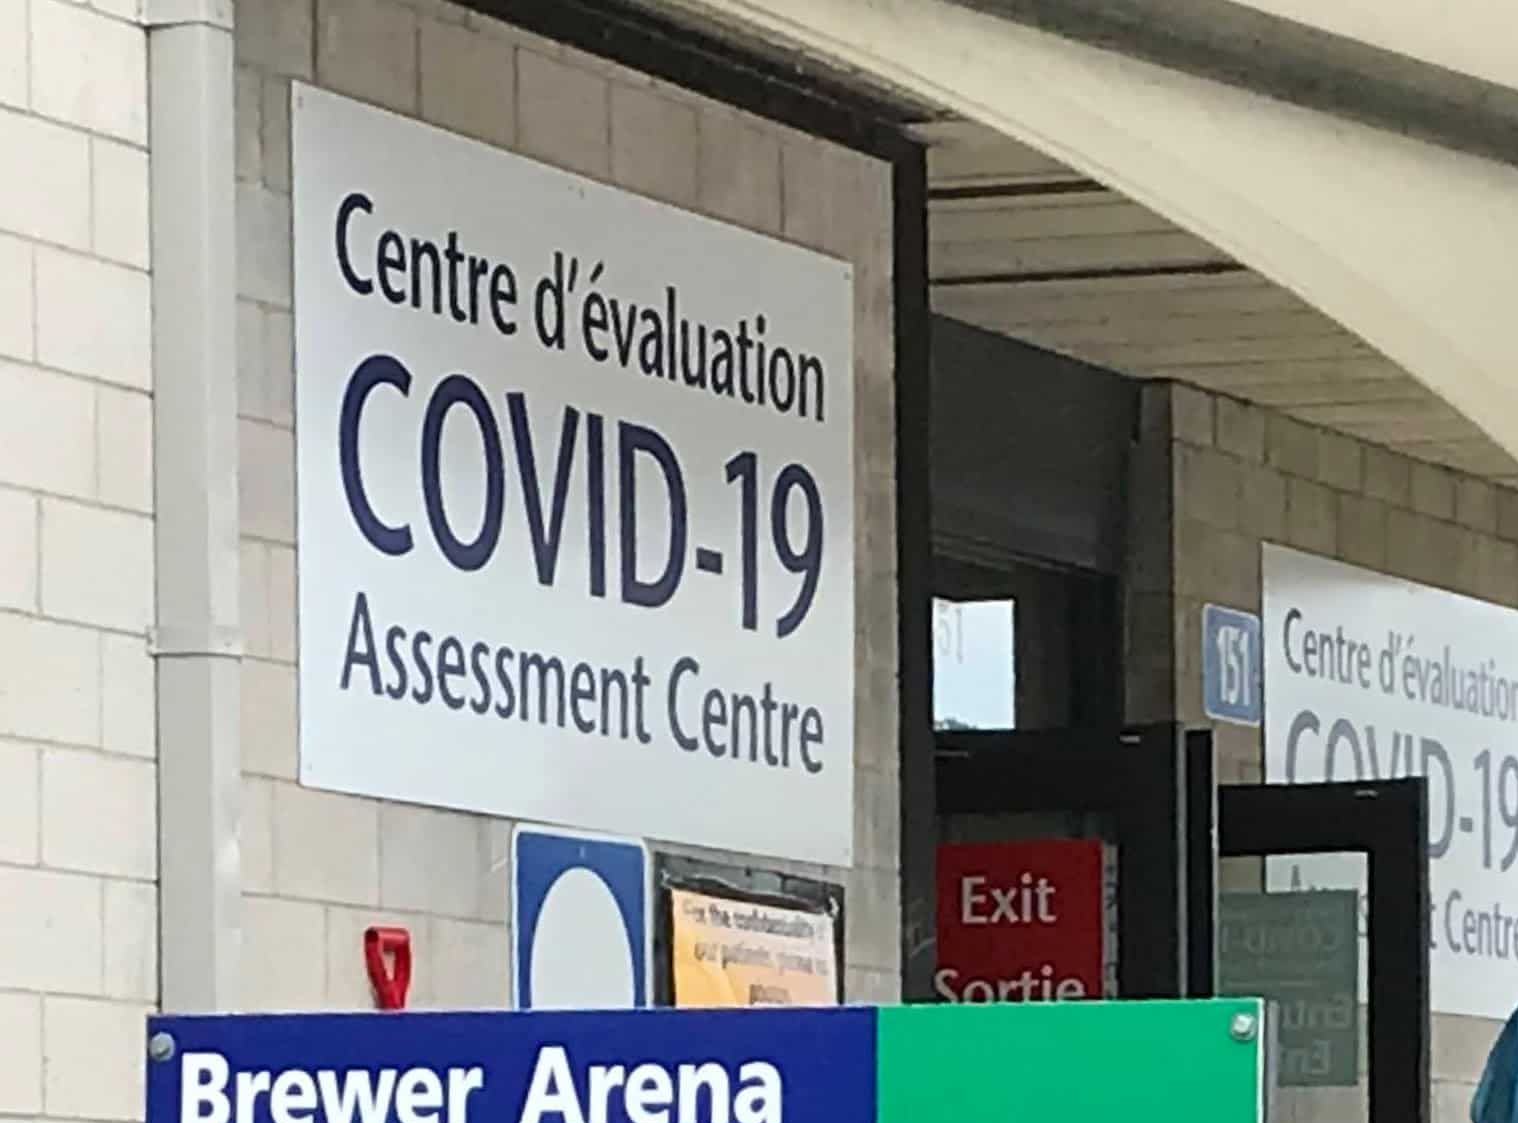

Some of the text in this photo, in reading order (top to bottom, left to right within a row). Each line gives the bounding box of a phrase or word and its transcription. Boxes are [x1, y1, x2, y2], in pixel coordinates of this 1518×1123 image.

[335, 192, 825, 422] Centre d'évaluation
[338, 353, 824, 639] COVID-19
[339, 591, 824, 774] Assessment Centre
[1216, 624, 1249, 707] 151
[1283, 607, 1372, 689] Centre
[960, 872, 1057, 924] Exit
[933, 964, 1086, 1003] Sortie
